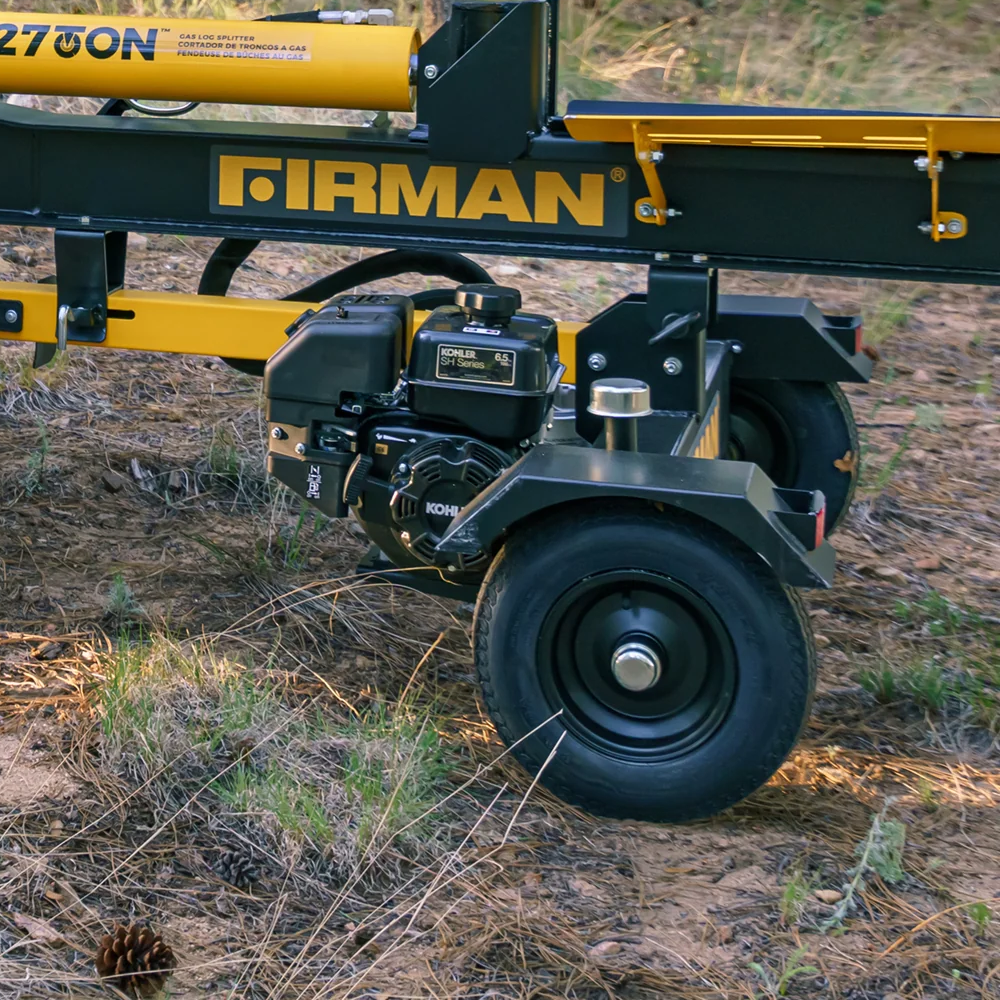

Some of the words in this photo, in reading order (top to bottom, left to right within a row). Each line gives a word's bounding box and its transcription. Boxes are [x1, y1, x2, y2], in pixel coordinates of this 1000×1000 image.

[178, 41, 223, 49] CORTADOR
[239, 43, 279, 51] TRONCOS
[177, 50, 221, 58] FENDEUSE
[236, 50, 270, 59] BÛCHES
[441, 348, 476, 359] KOHLER
[440, 356, 455, 366] SH
[457, 358, 485, 369] Series
